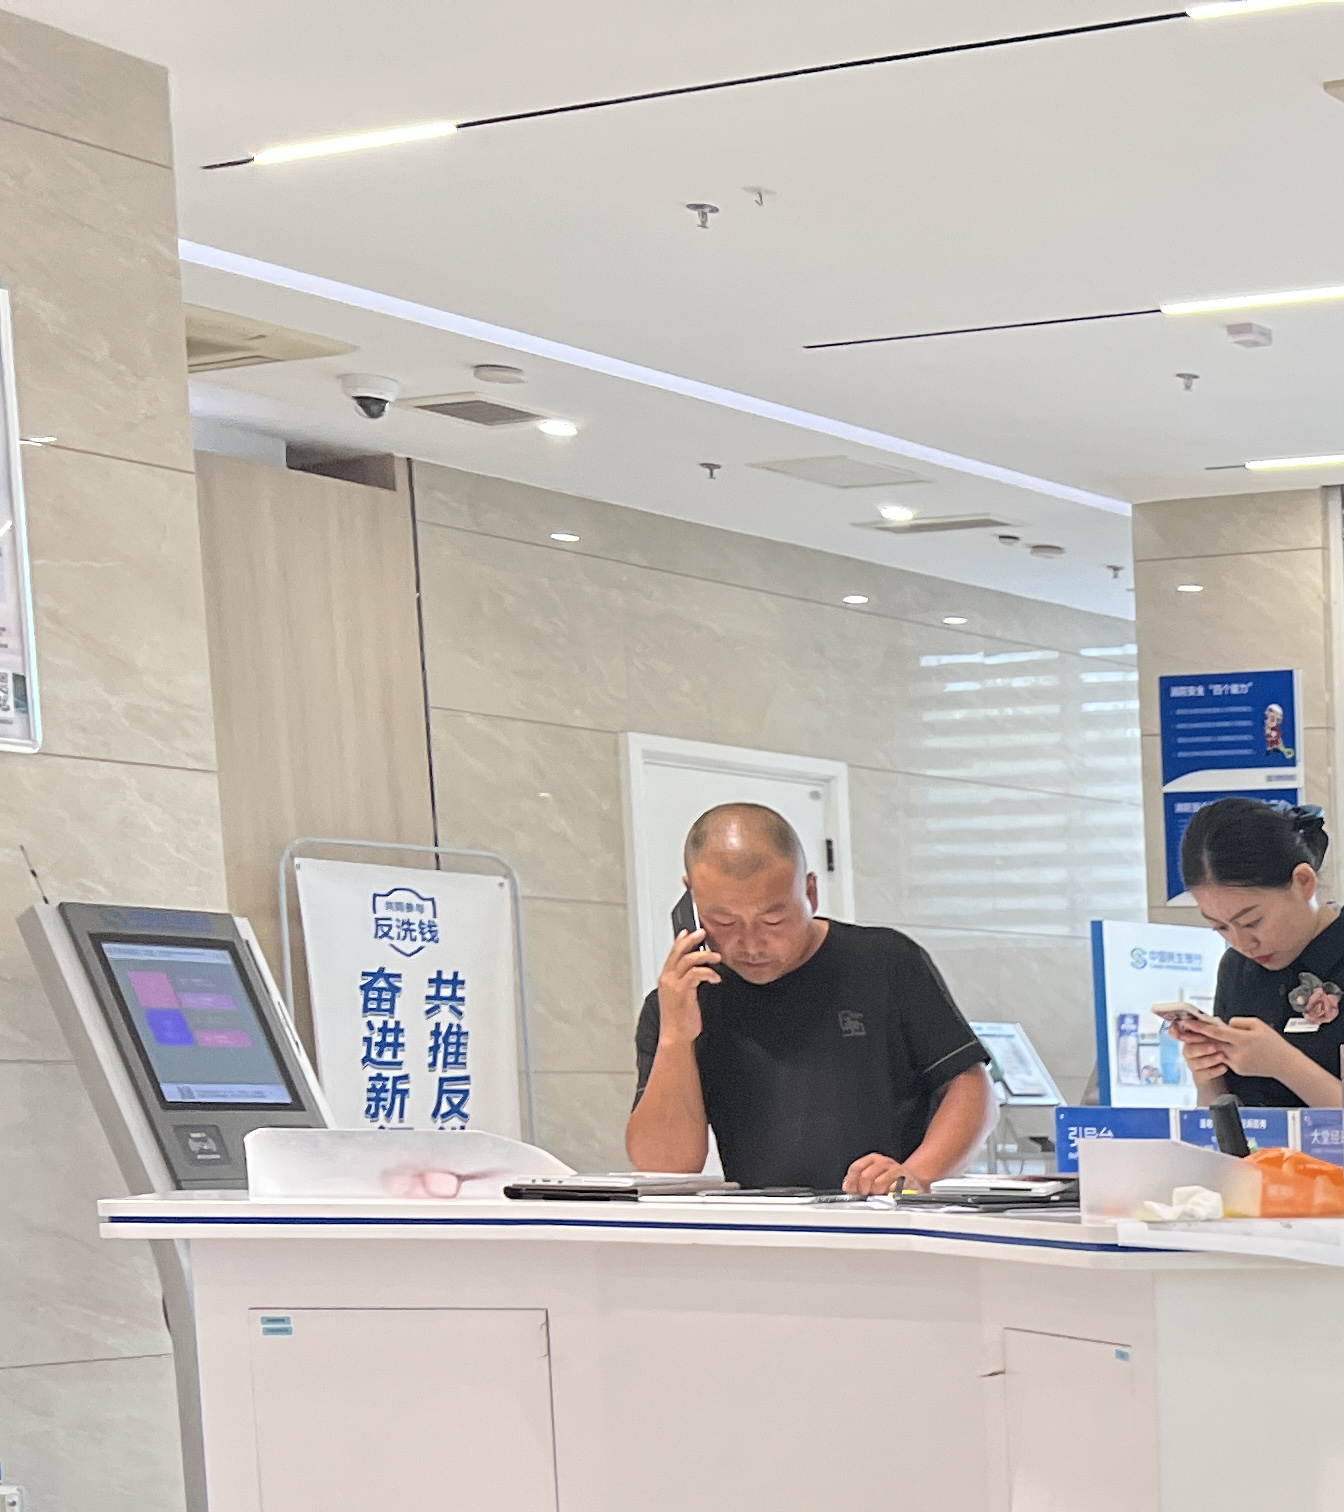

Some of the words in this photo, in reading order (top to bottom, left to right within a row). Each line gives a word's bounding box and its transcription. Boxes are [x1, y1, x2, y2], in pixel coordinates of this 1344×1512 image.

[374, 917, 439, 944] 反洗钱
[359, 966, 411, 1130] 奋进新
[424, 969, 472, 1130] 共推反
[1311, 1129, 1344, 1144] 大堂经
